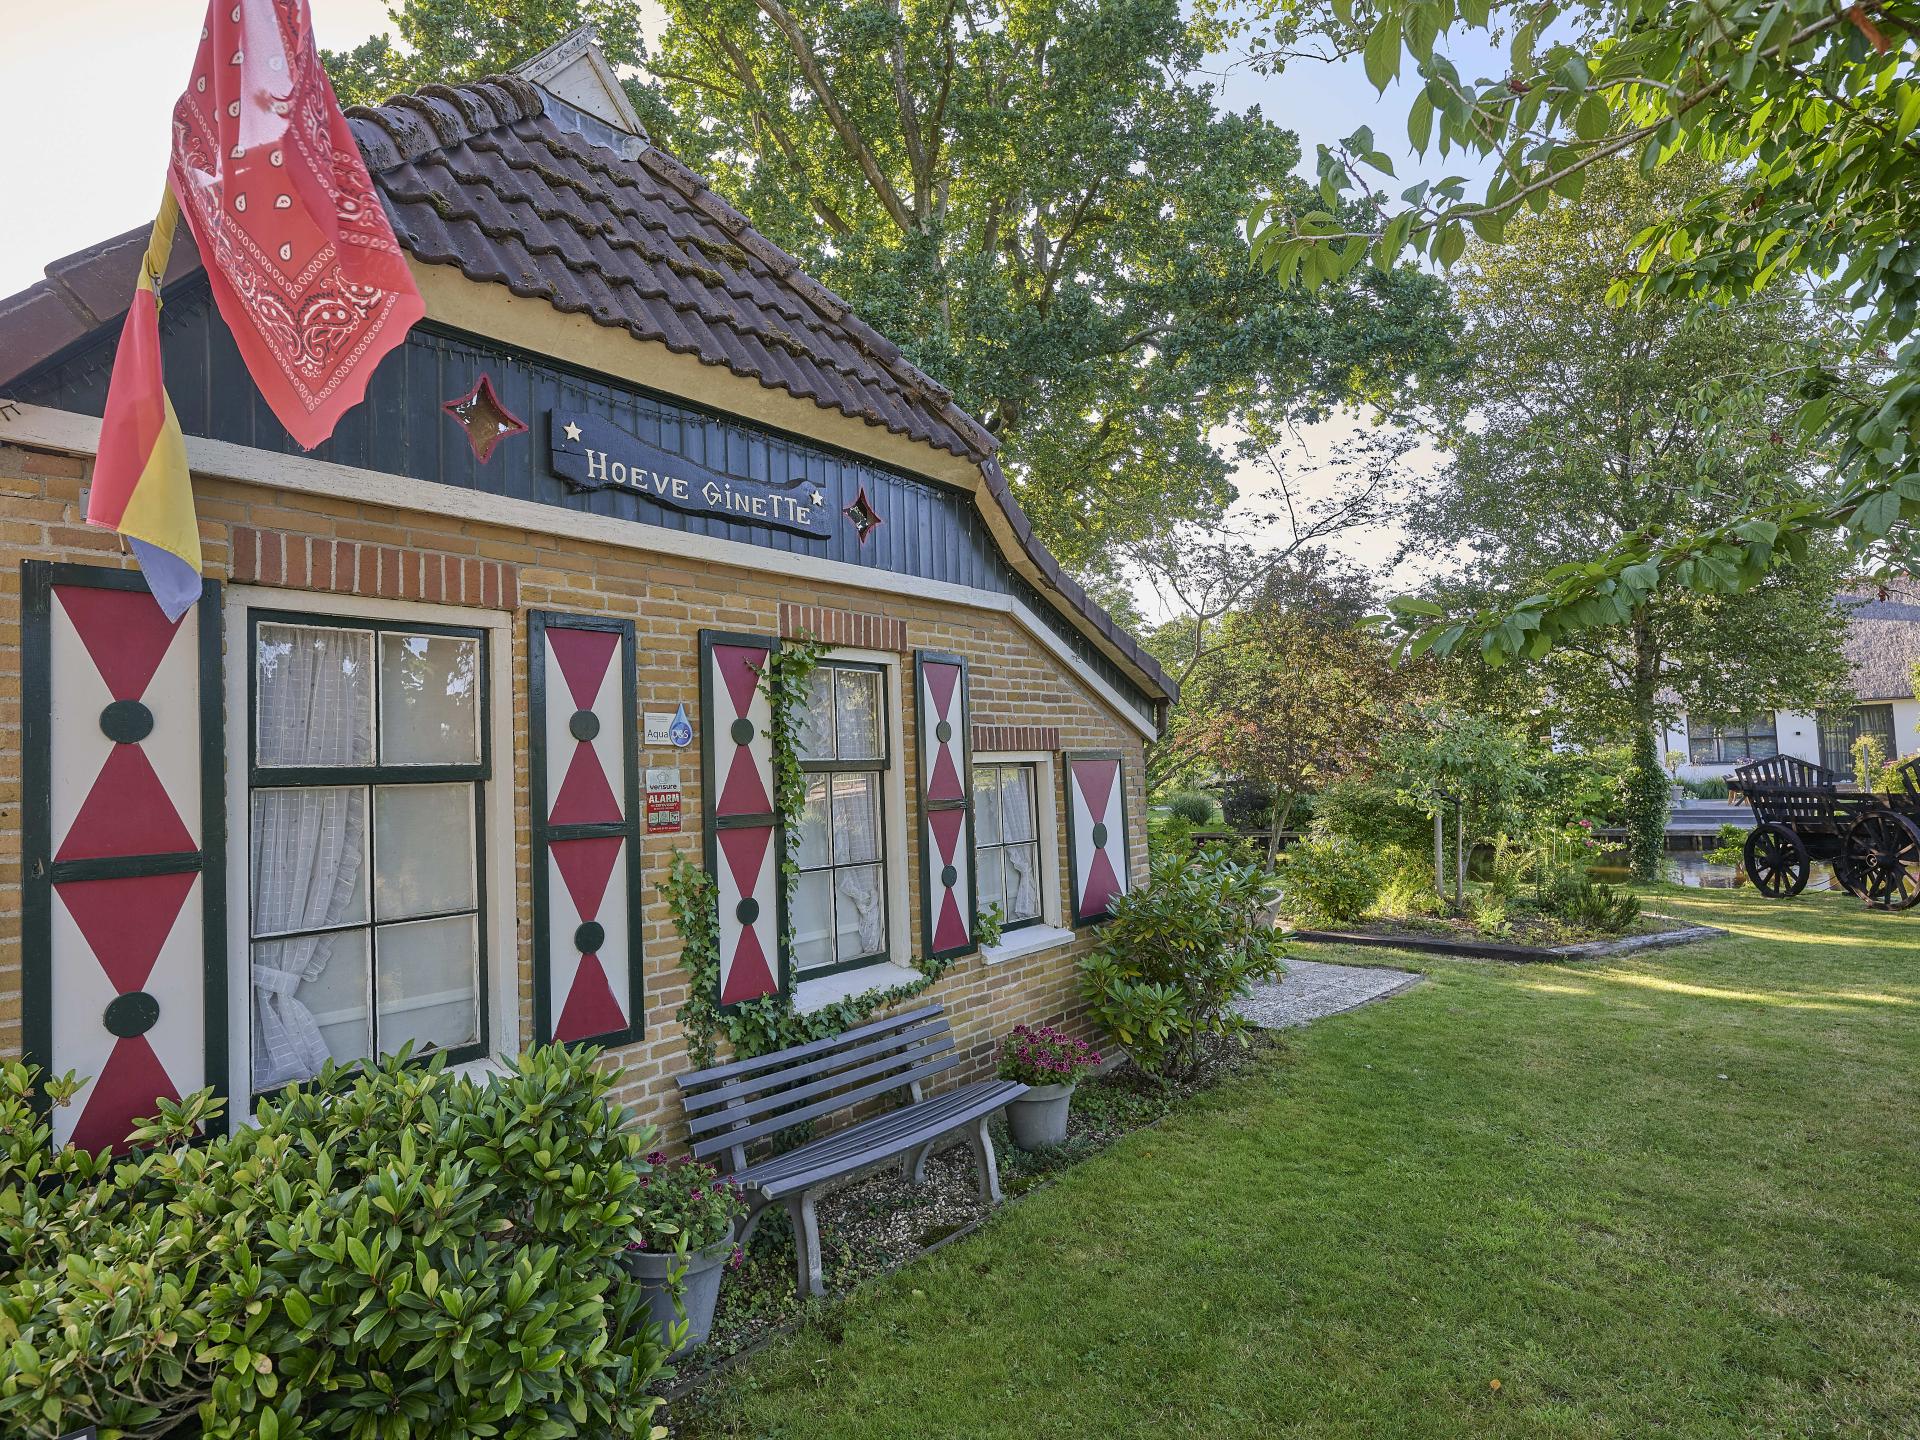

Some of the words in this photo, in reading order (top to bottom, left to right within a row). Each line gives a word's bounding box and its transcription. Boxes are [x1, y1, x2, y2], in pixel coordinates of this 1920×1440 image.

[584, 449, 690, 500] HOEVE
[647, 729, 669, 740] Aqua
[649, 794, 680, 804] ALARM
